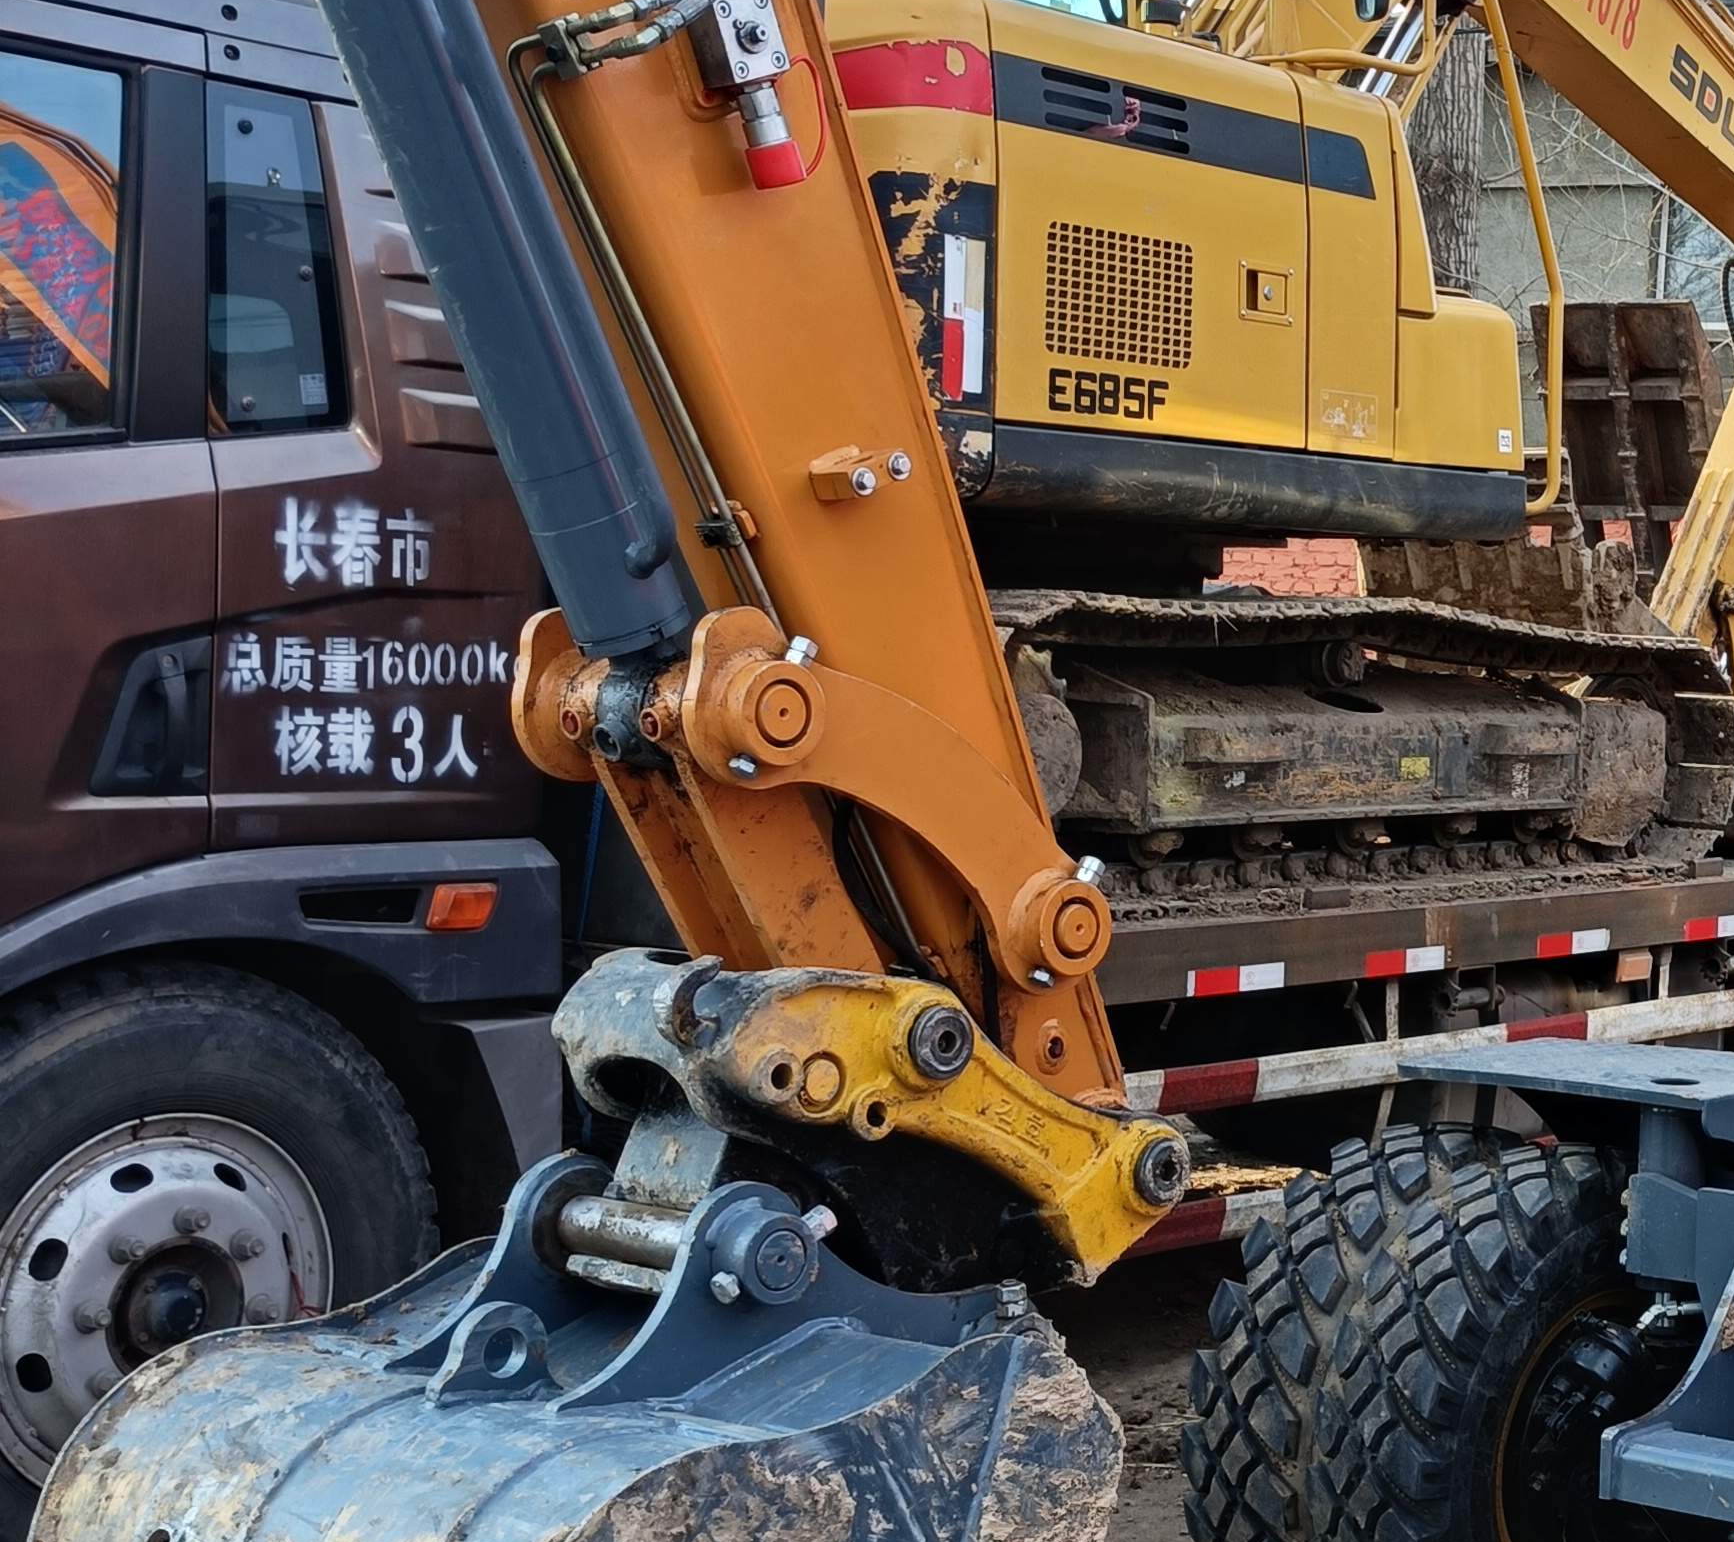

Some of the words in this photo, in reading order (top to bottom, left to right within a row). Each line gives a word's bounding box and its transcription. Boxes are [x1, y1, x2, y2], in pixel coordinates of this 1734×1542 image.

[1049, 368, 1169, 420] E685F
[274, 497, 436, 587] 长春市
[222, 633, 525, 695] 总质量16000k
